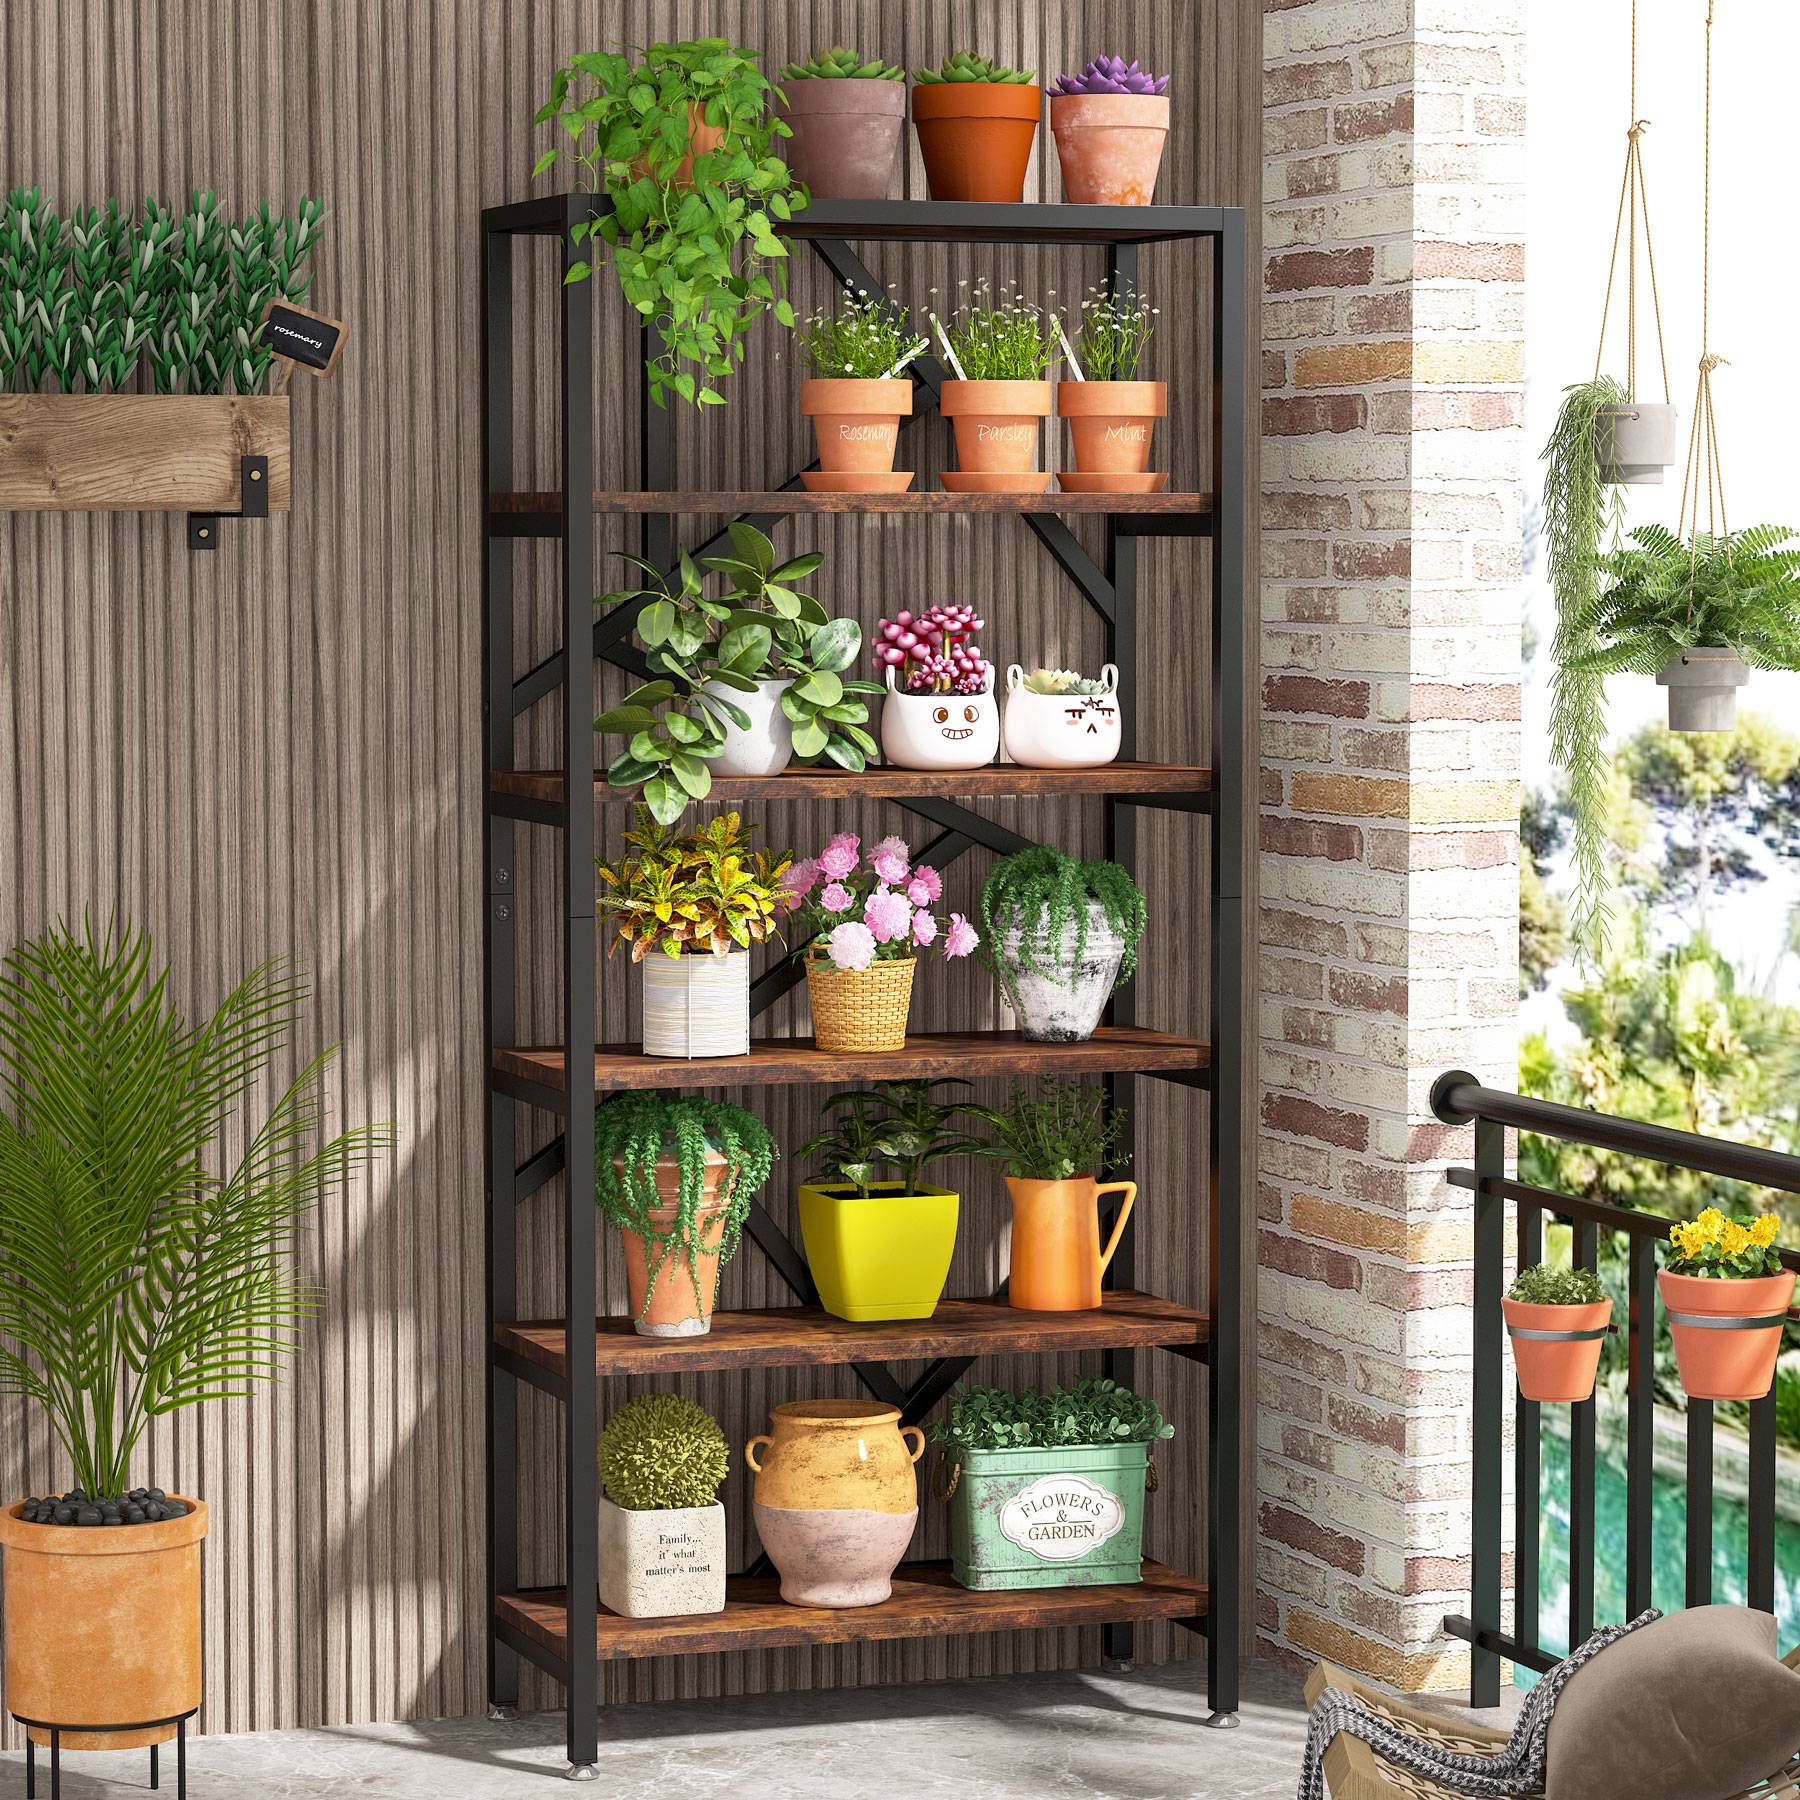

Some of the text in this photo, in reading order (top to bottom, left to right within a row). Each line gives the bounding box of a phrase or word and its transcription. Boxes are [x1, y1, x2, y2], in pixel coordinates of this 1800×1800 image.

[274, 325, 323, 349] rosemary
[840, 424, 894, 451] Rosemary
[978, 424, 1033, 452] Parsley
[1104, 421, 1148, 442] Mint
[1020, 1493, 1104, 1518] FLOWERS
[1056, 1509, 1068, 1523] &
[659, 1533, 701, 1545] Family...
[1028, 1524, 1095, 1541] GARDEN
[673, 1549, 695, 1559] what
[645, 1564, 711, 1576] matter's most
